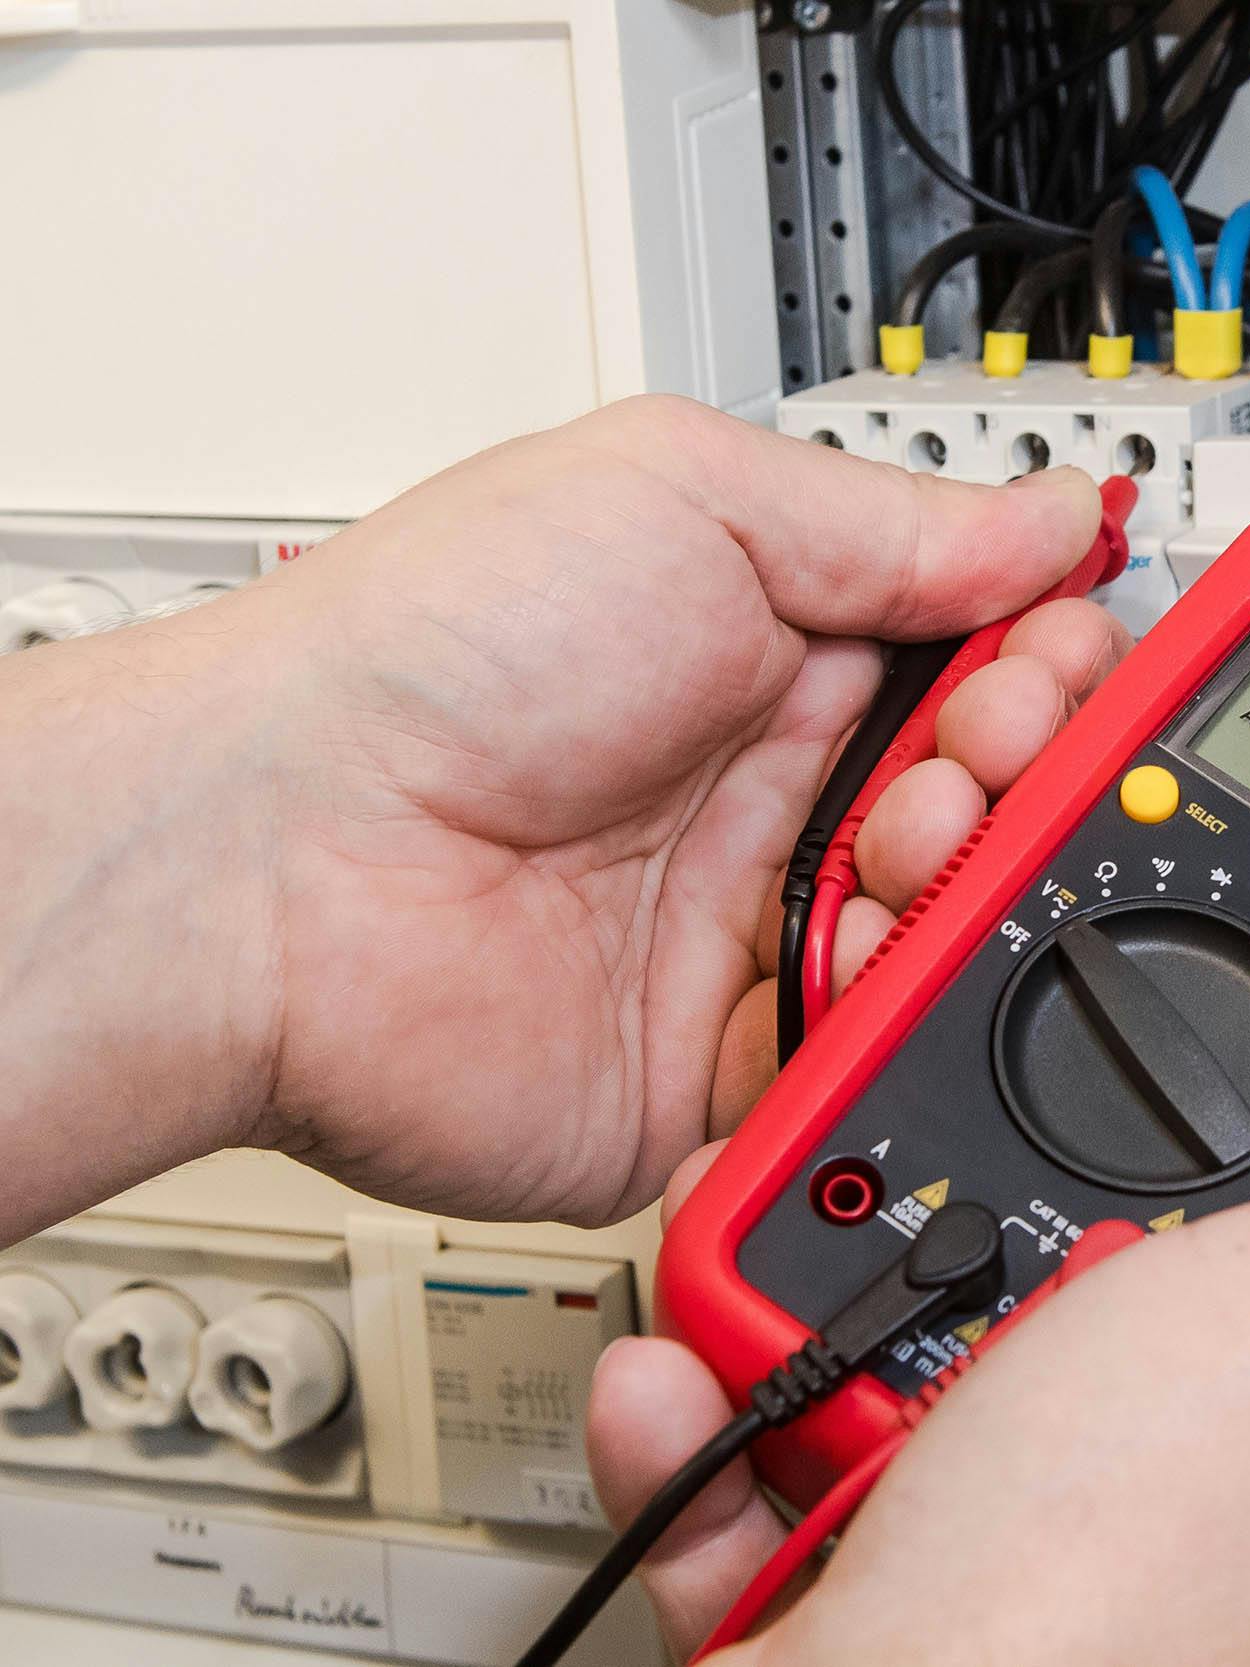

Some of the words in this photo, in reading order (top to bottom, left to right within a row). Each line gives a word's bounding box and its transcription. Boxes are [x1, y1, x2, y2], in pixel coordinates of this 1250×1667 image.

[1185, 801, 1229, 836] SELECT
[999, 919, 1033, 945] OFF
[869, 1138, 892, 1160] A
[1029, 1199, 1058, 1222] CAT
